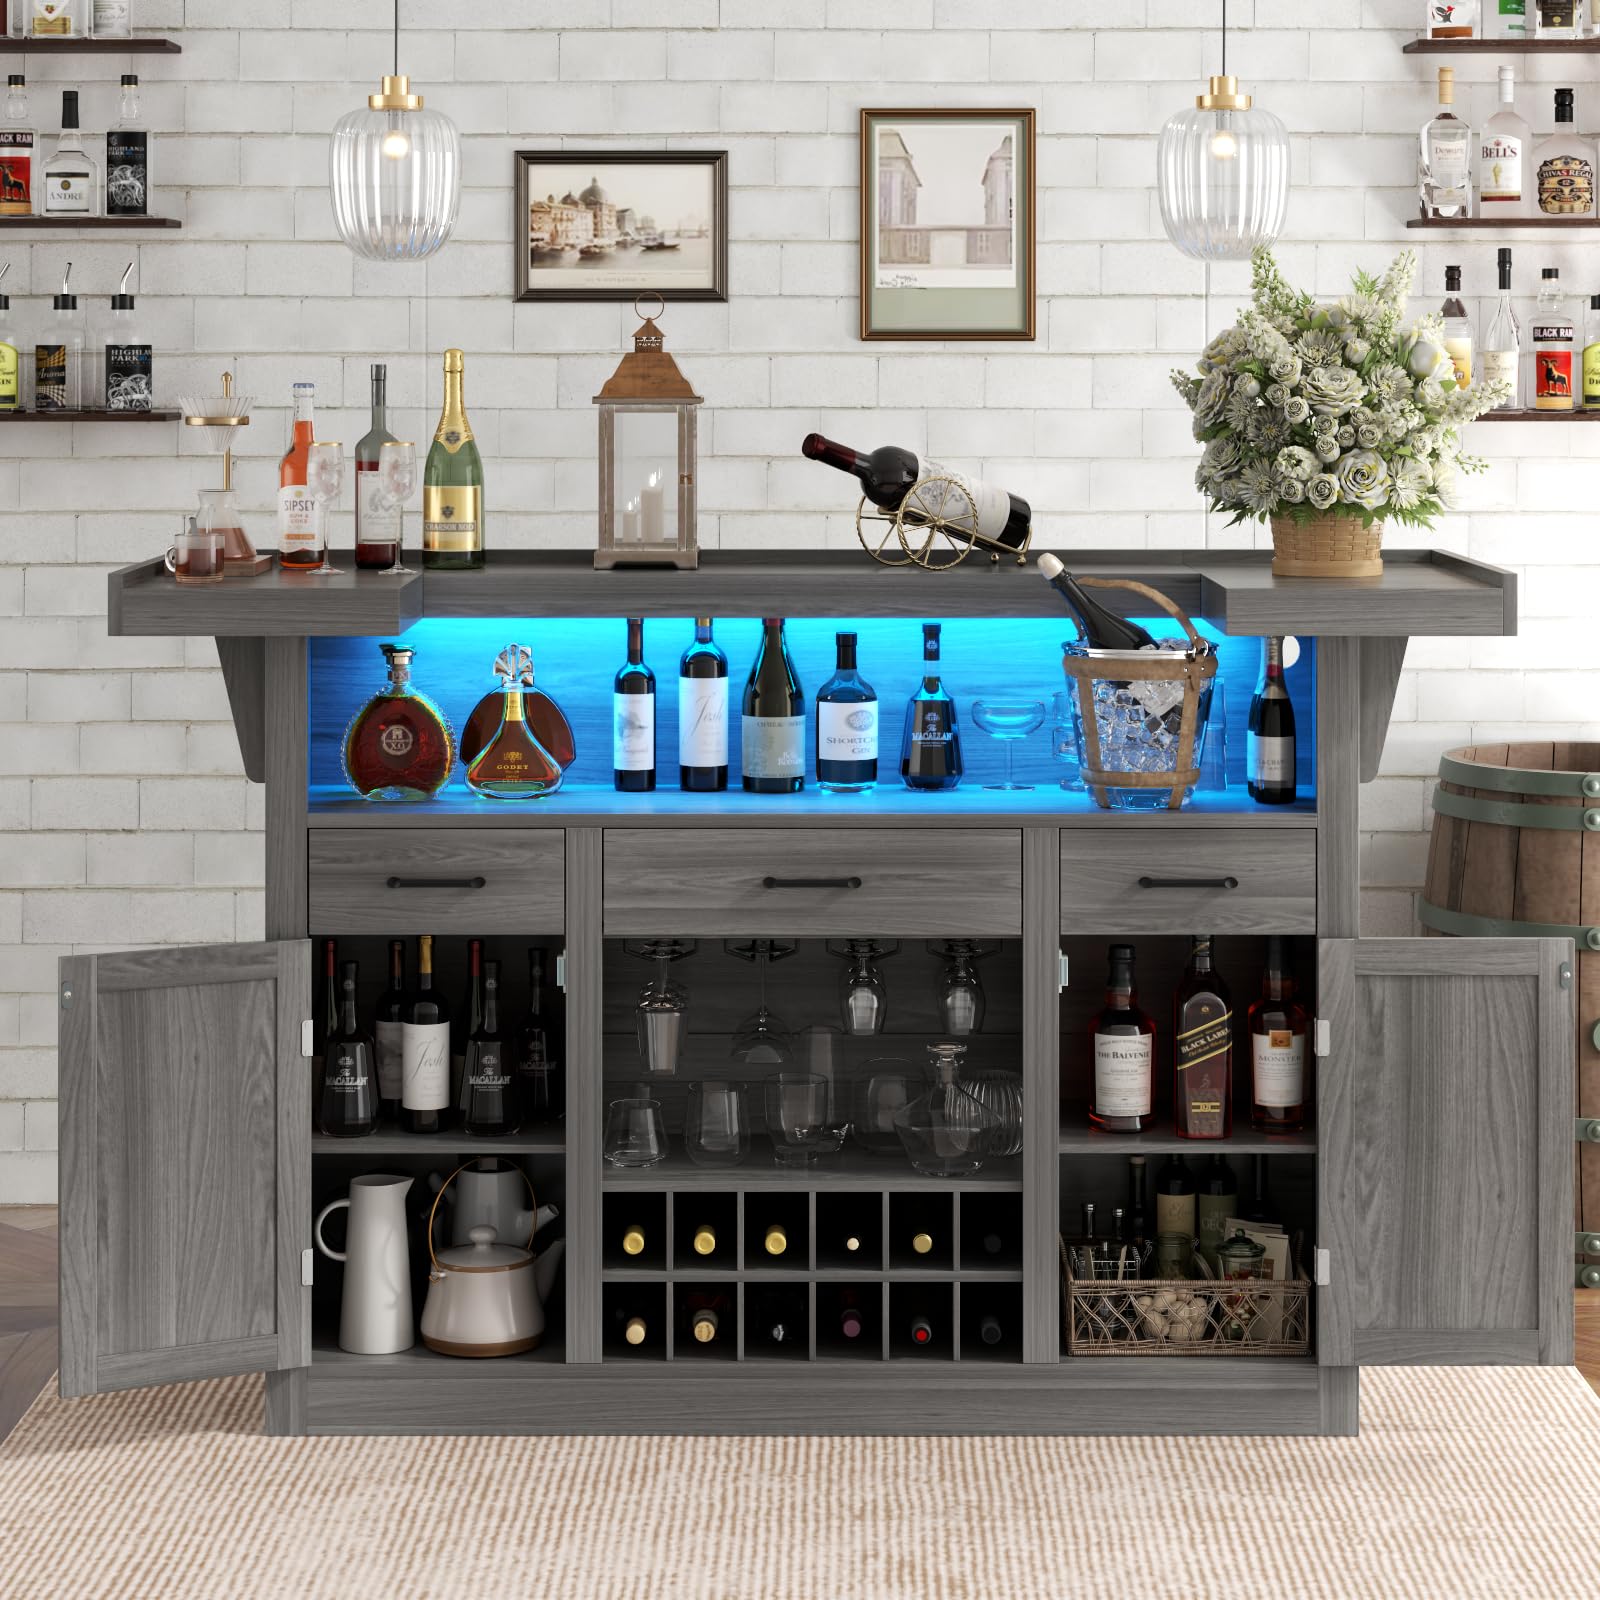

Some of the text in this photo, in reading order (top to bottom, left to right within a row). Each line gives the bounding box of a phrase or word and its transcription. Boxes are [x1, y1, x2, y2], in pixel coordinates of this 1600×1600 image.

[1481, 145, 1518, 159] BELL'S
[284, 499, 315, 511] SIPSEY
[1180, 1038, 1207, 1054] BLACK
[1206, 1027, 1231, 1042] LABEL
